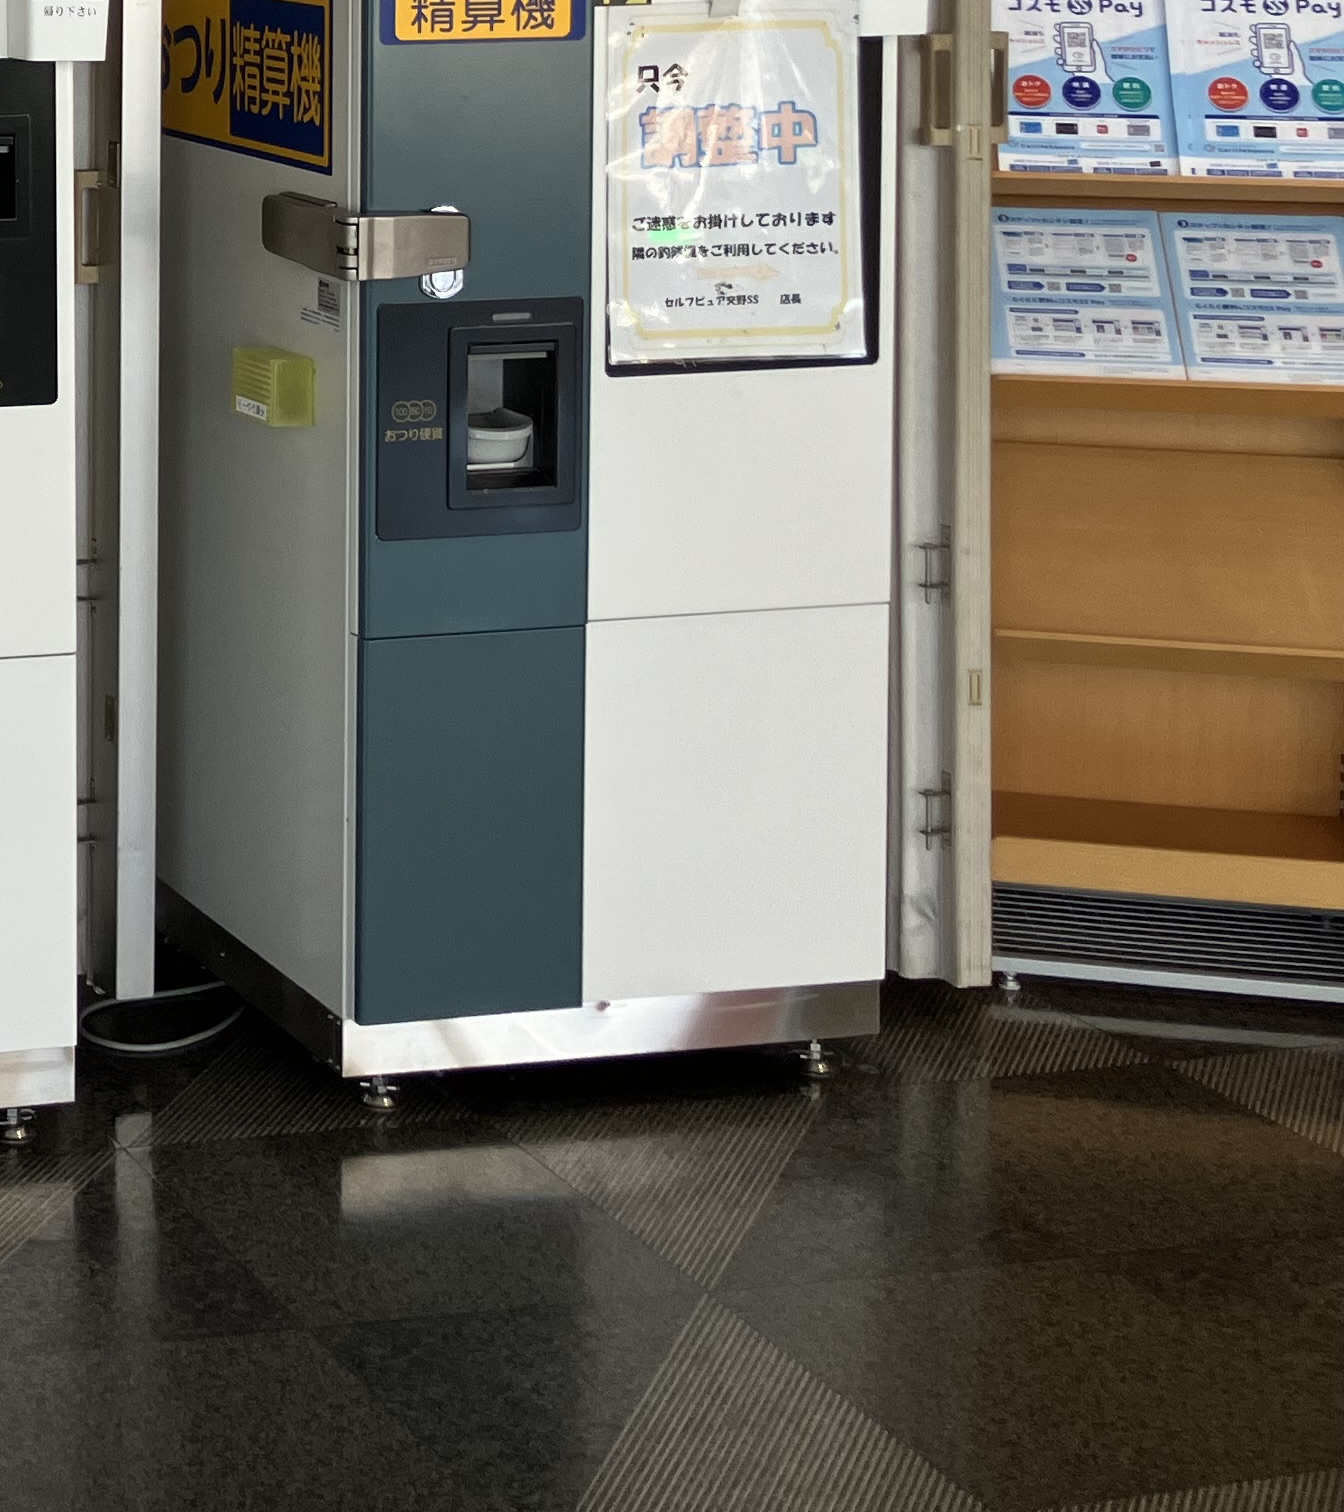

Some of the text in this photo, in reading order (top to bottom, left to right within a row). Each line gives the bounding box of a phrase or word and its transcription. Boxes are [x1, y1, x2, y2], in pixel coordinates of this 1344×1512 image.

[43, 5, 98, 17] 帰り下さい
[636, 62, 689, 94] 只今
[638, 100, 818, 169] 調整中
[631, 211, 837, 232] ご迷惑をお掛けしております
[664, 294, 760, 308] セルフピュア交野SS
[779, 292, 802, 305] 店長
[384, 426, 444, 443] おつり硬貨
